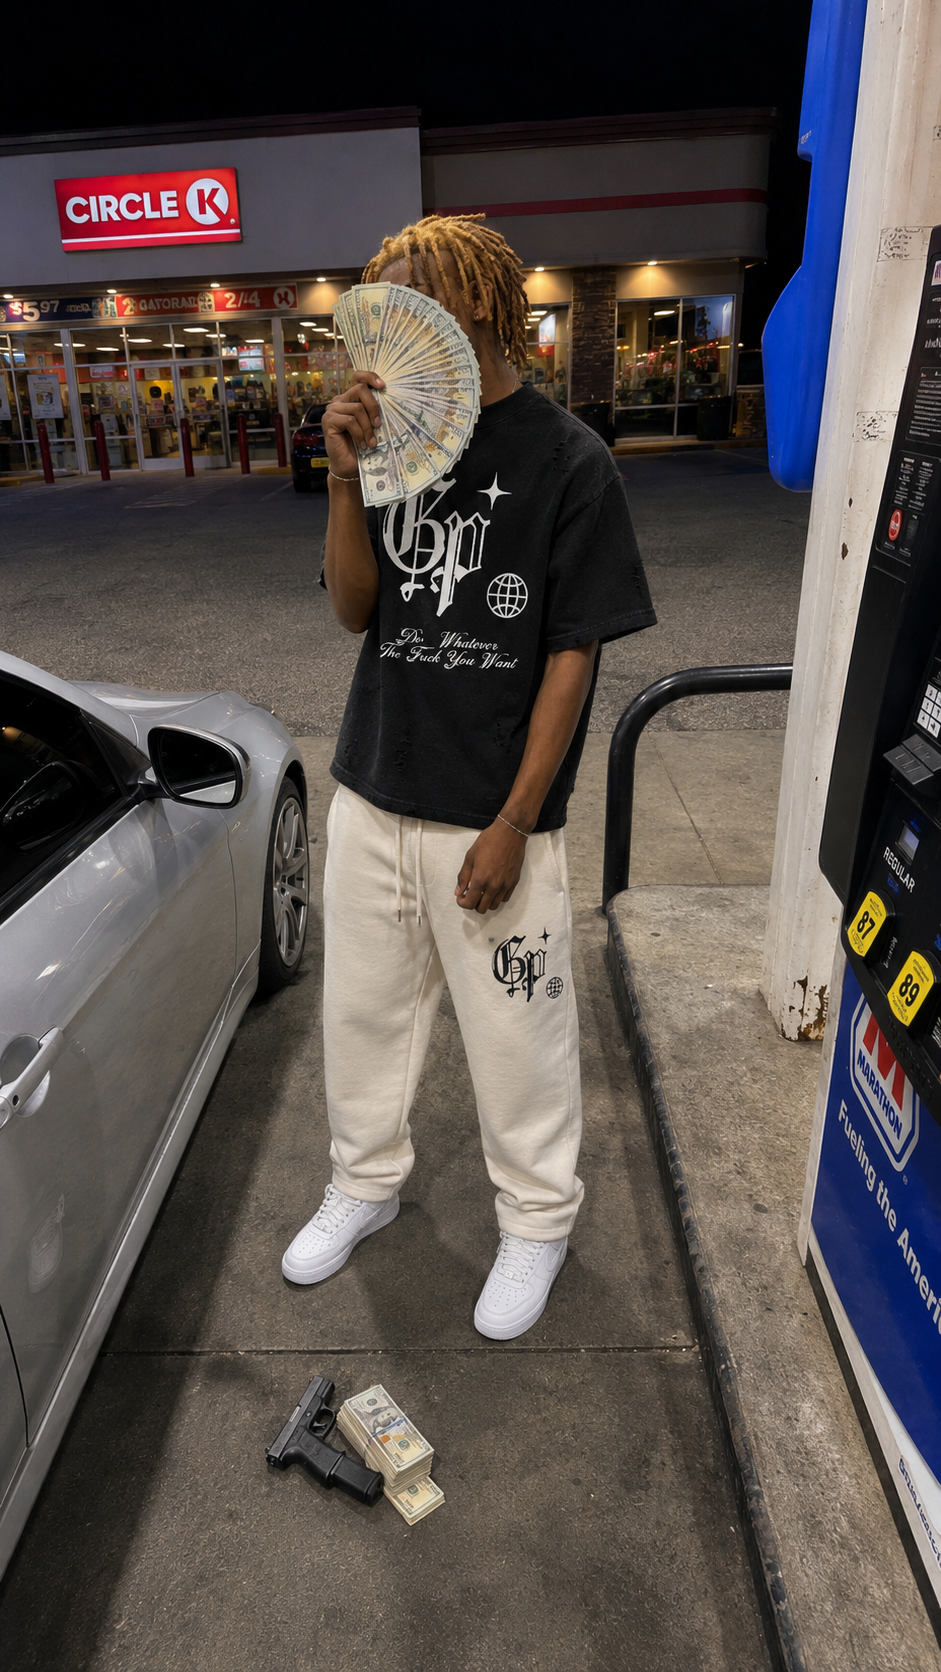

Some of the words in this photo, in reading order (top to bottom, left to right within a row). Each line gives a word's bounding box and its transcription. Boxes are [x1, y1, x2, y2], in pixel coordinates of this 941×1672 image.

[65, 190, 180, 224] CIRCLE
[194, 186, 228, 224] K
[380, 642, 401, 659] The
[406, 645, 442, 662] Fuck
[443, 650, 476, 670] You
[479, 652, 519, 670] Want
[439, 631, 499, 651] Whatever
[882, 846, 916, 893] REGULAR
[856, 910, 876, 940] 87
[898, 973, 921, 1007] 89
[856, 1048, 903, 1141] MARATHON
[837, 1099, 877, 1192] Fueling
[876, 1180, 898, 1232] the
[897, 1228, 941, 1335] Ameri
